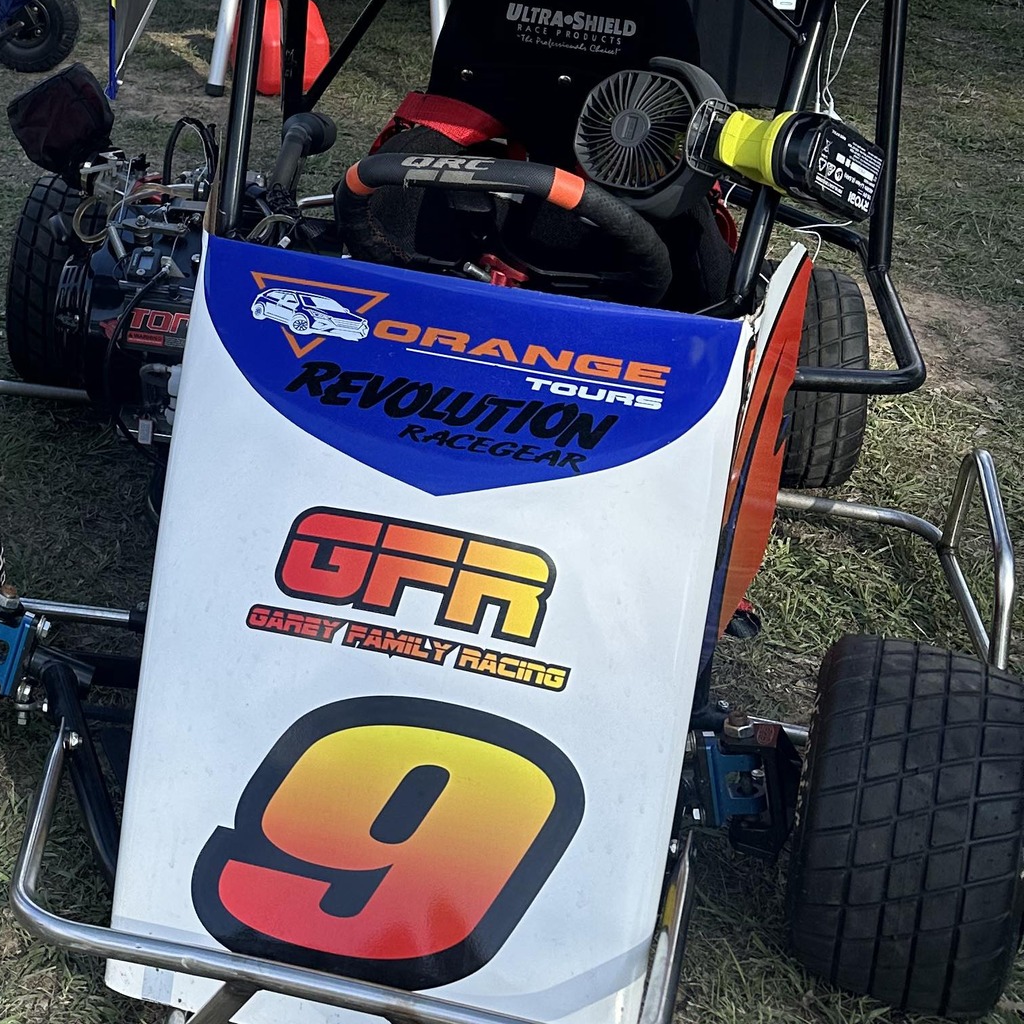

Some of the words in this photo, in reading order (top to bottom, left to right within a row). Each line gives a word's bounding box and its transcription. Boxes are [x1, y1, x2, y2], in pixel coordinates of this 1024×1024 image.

[517, 23, 548, 35] RACE
[556, 29, 622, 46] PRODUCTS
[400, 156, 496, 170] QRC
[373, 319, 672, 387] ORANGE
[283, 360, 619, 451] REVOLUTION
[525, 376, 664, 411] TOURS
[397, 423, 588, 474] RACEGEAR
[280, 511, 551, 642] GFR
[249, 606, 344, 640] GAREY
[345, 624, 452, 662] FAMILY
[458, 648, 568, 689] RACING
[212, 719, 564, 966] 9
